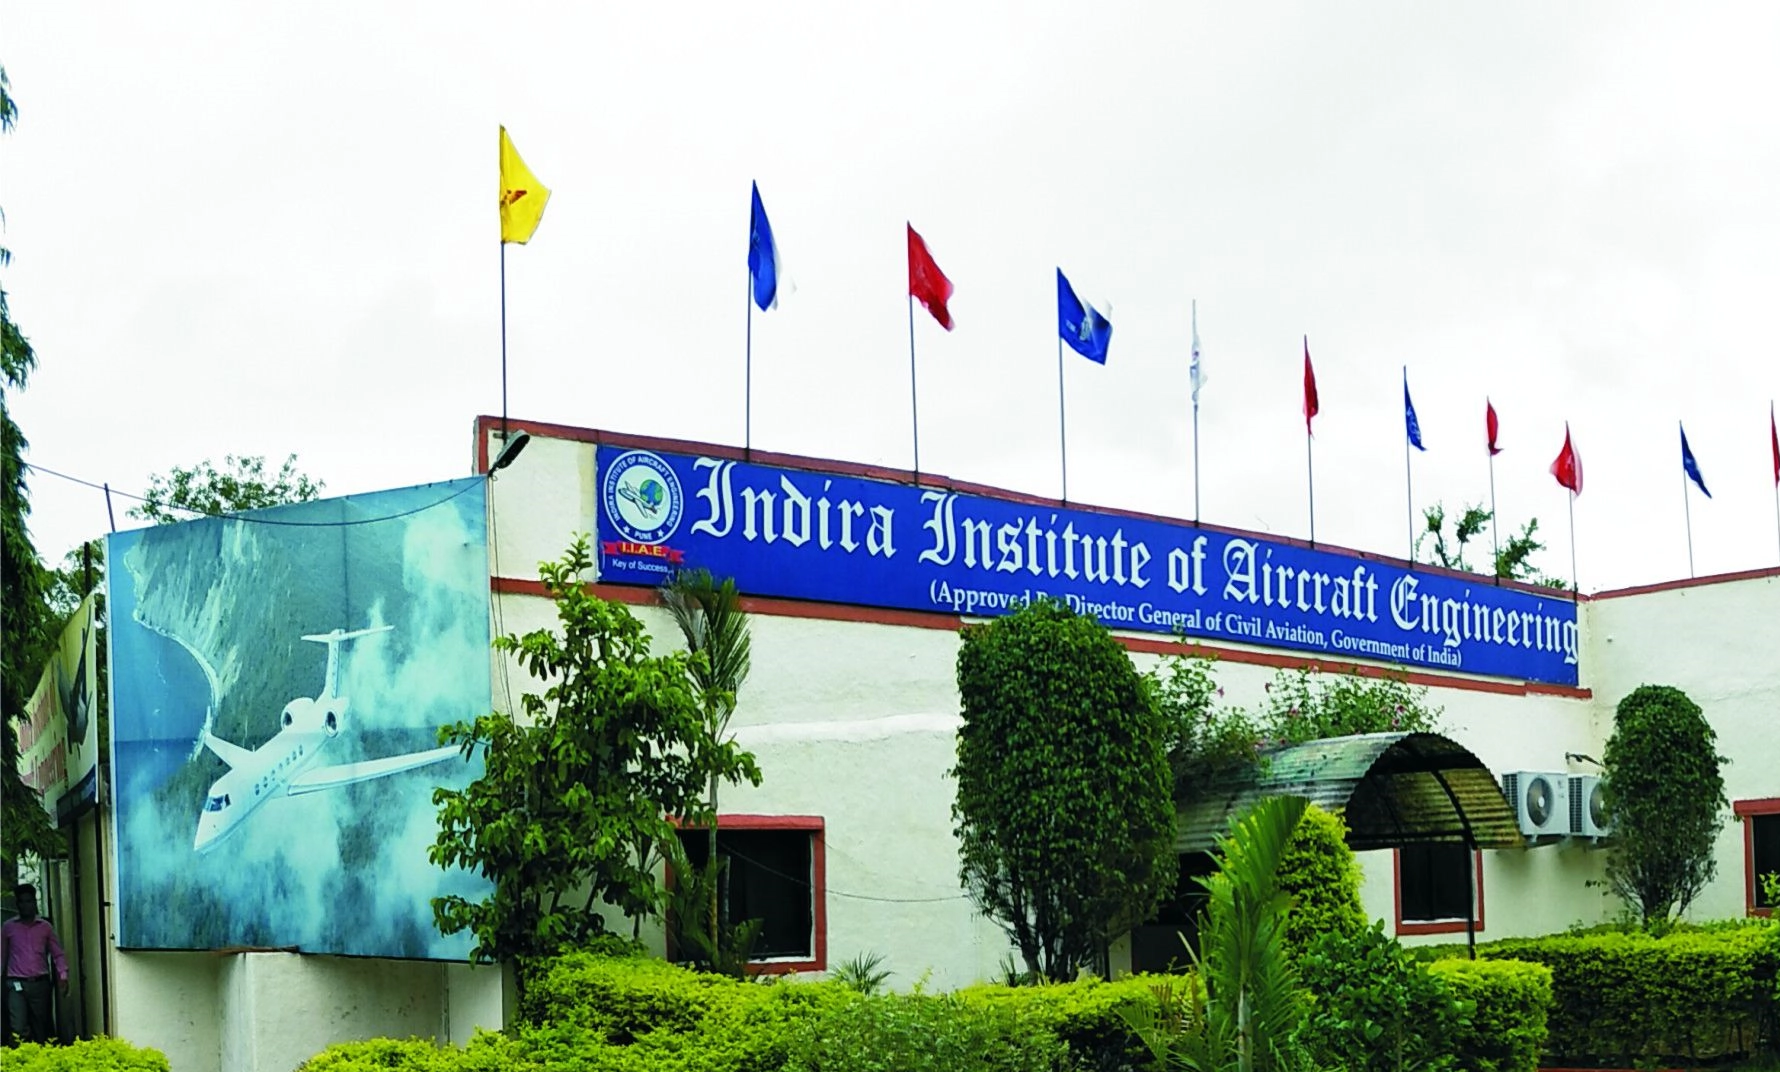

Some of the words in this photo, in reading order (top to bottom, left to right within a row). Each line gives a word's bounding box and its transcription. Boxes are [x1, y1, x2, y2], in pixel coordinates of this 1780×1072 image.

[627, 456, 636, 464] OF
[638, 456, 668, 477] AIRCRAFT
[666, 475, 680, 527] ENGINEERING
[612, 559, 627, 571] Key
[629, 561, 636, 569] of
[634, 531, 652, 540] PUNE
[691, 458, 898, 559] Indira
[919, 491, 1151, 588] Institute
[1167, 535, 1207, 596] of
[1223, 538, 1378, 624] Aircraft
[1390, 576, 1578, 665] Engineering
[930, 579, 1030, 612] (Approved
[1065, 594, 1134, 622] Director
[1138, 603, 1201, 629] General
[1205, 614, 1222, 631] of
[1225, 614, 1261, 637] Civil
[1265, 623, 1328, 648] Aviation,
[1331, 628, 1410, 659] Government
[1412, 645, 1425, 661] of
[1427, 645, 1462, 668] India)
